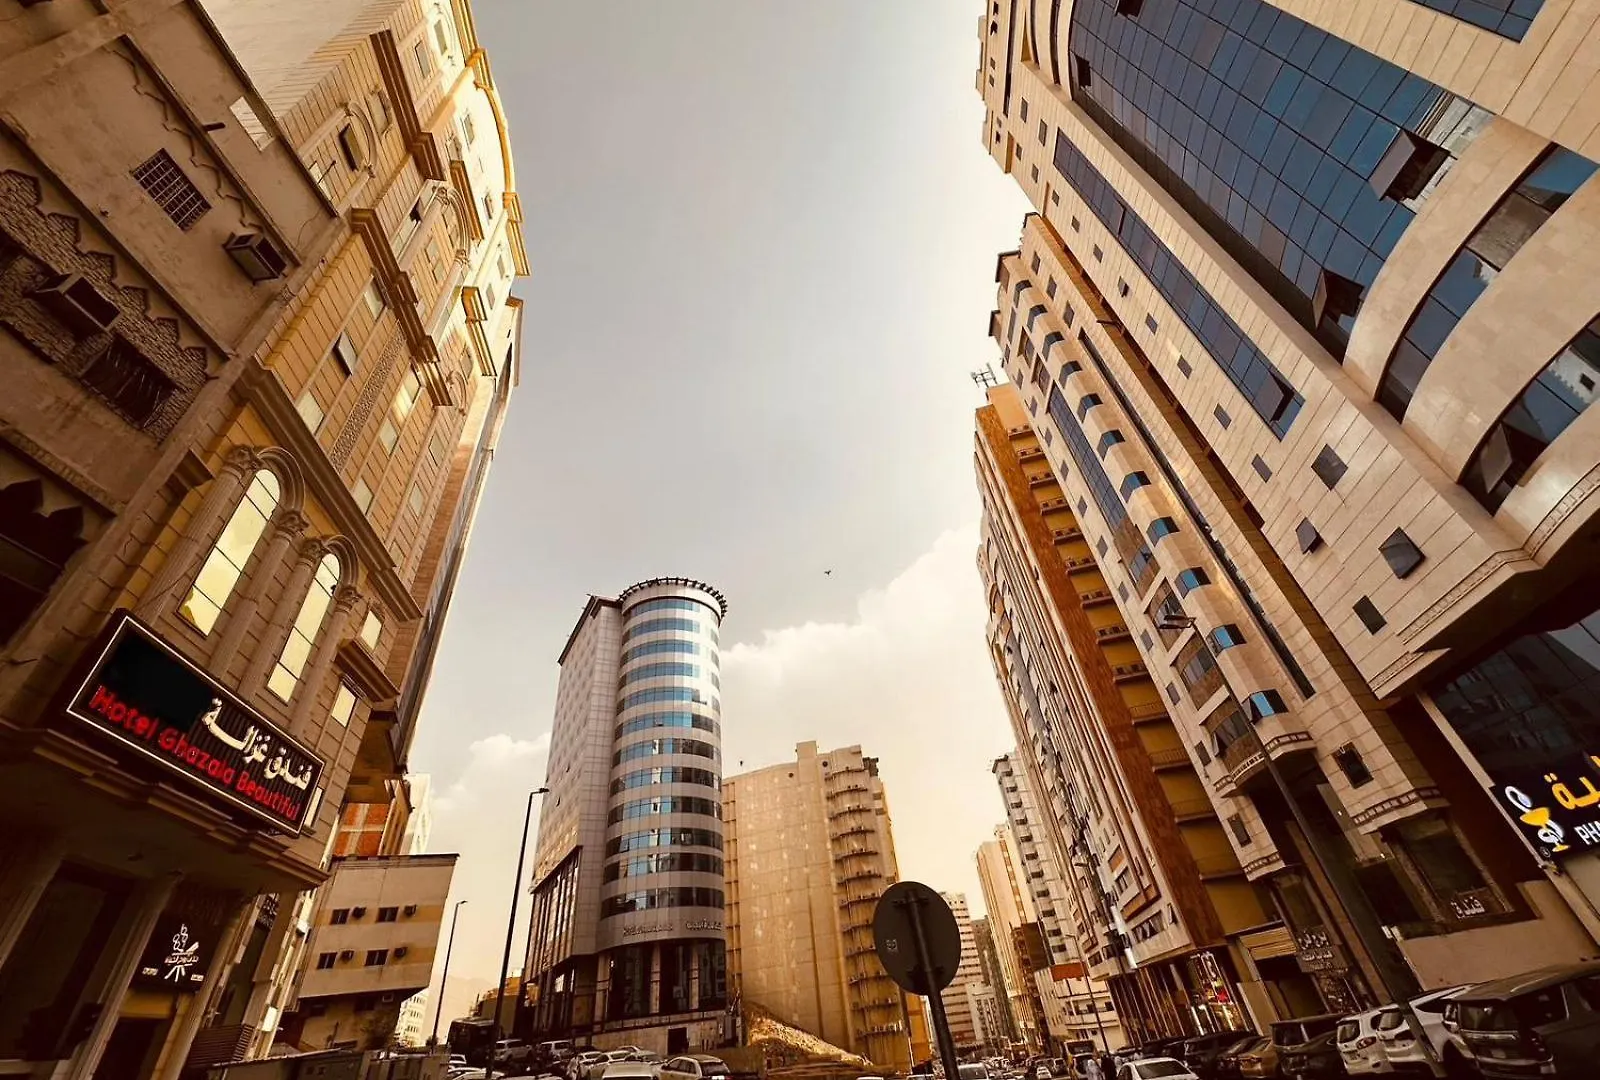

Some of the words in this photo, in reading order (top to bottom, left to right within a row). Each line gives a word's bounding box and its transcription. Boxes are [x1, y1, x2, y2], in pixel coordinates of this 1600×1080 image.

[88, 685, 160, 741] Hotel
[158, 727, 235, 785] Ghazala
[236, 771, 301, 821] Beautiful
[264, 748, 313, 790] فندق
